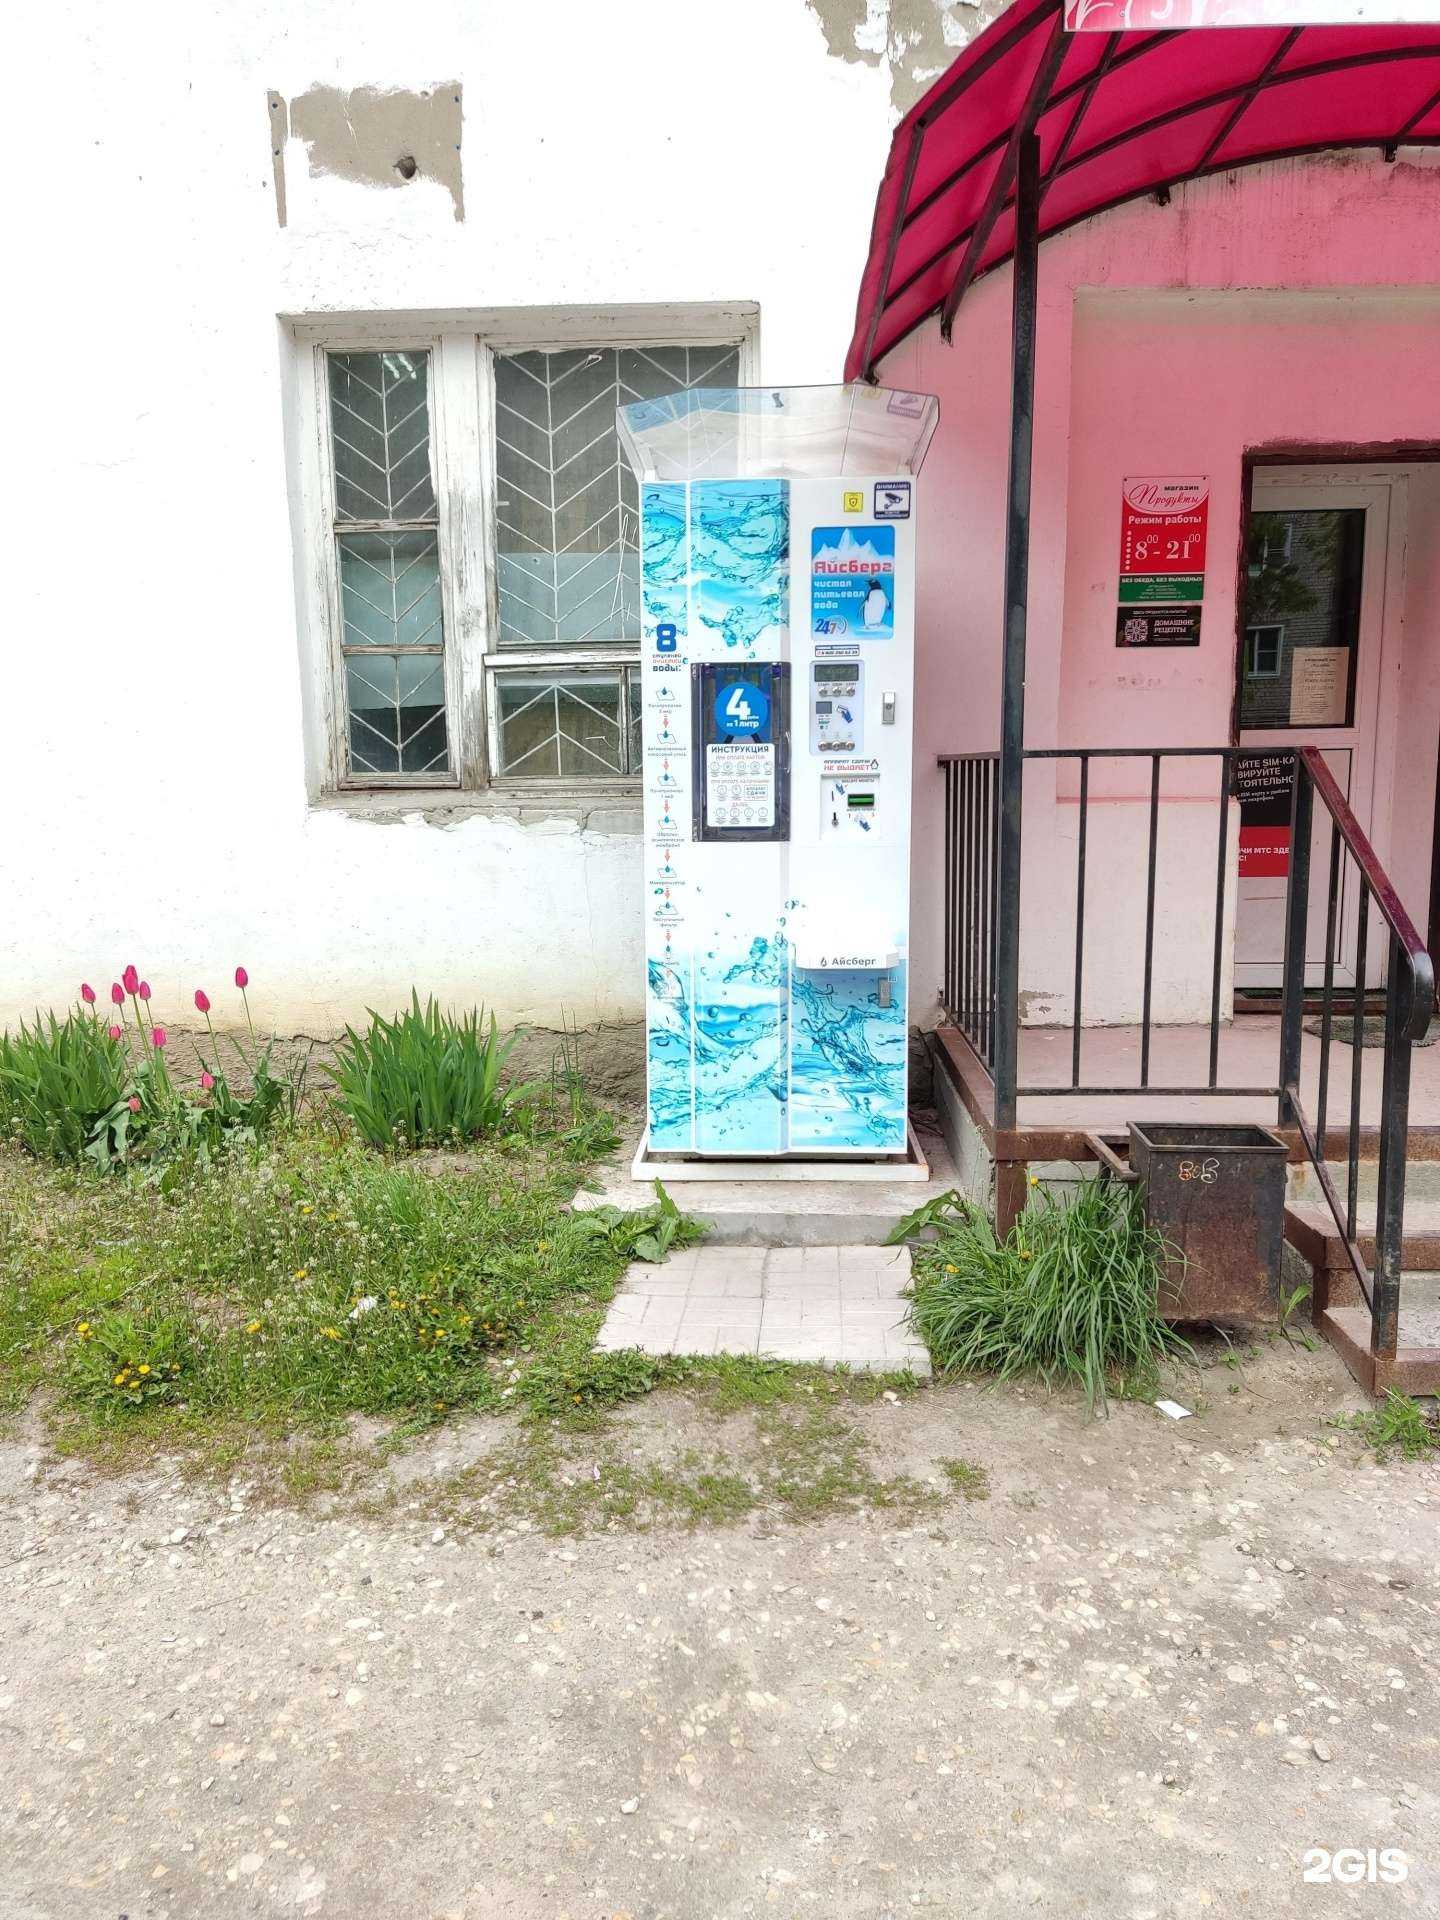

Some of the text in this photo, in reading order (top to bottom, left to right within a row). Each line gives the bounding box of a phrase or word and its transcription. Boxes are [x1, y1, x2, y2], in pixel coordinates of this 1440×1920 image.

[1129, 483, 1199, 508] Продукты
[1128, 514, 1202, 526] Режим работы
[813, 560, 892, 574] Айсберг
[814, 590, 865, 598] питьевая
[814, 600, 838, 609] вода
[1154, 619, 1194, 627] ДОМАШНИЕ
[656, 623, 677, 652] 8
[652, 664, 682, 672] воды:
[726, 688, 751, 720] 4
[739, 720, 760, 729] литр
[711, 745, 769, 753] ИНСТРУКЦИЯ
[1237, 767, 1280, 779] ВИРУЙТЕ
[831, 957, 876, 966] Айсберг
